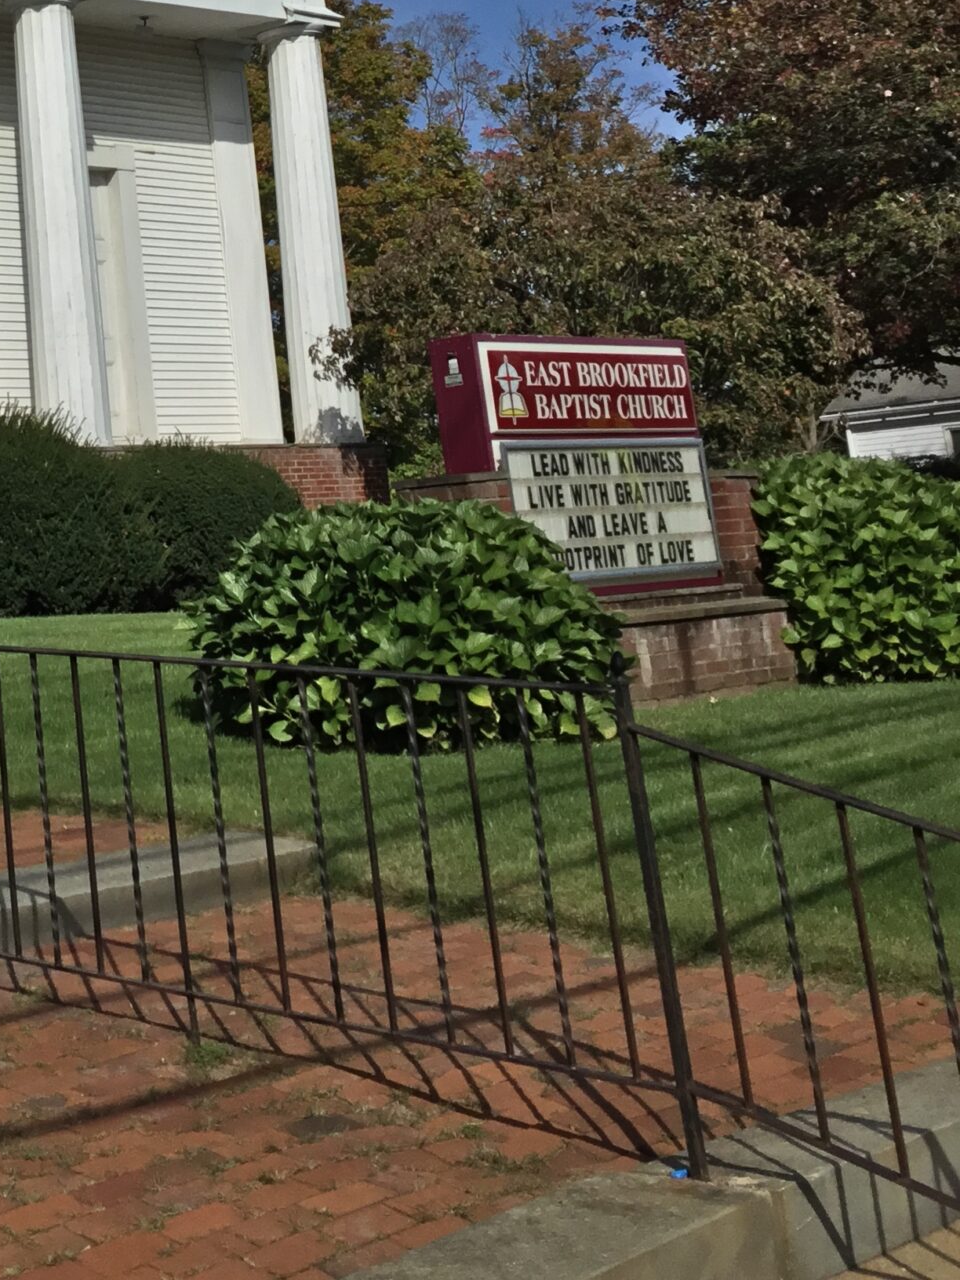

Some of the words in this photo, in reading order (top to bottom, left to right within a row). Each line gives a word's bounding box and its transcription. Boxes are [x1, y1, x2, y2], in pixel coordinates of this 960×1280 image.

[523, 360, 571, 387] EAST
[576, 362, 687, 388] BROOKFIELD
[534, 394, 611, 419] BAPTIST
[616, 394, 688, 419] CHURCH
[530, 453, 569, 477] LEAD
[572, 452, 611, 475] WITH
[618, 451, 684, 473] KINDNESS
[527, 485, 565, 508] LIVE
[570, 483, 609, 506] WITH
[614, 480, 691, 504] GRATITUDE
[568, 515, 596, 538] AND
[602, 512, 648, 536] LEAVE
[657, 511, 668, 533] A
[636, 541, 654, 565] OF
[659, 540, 695, 563] LOVE
